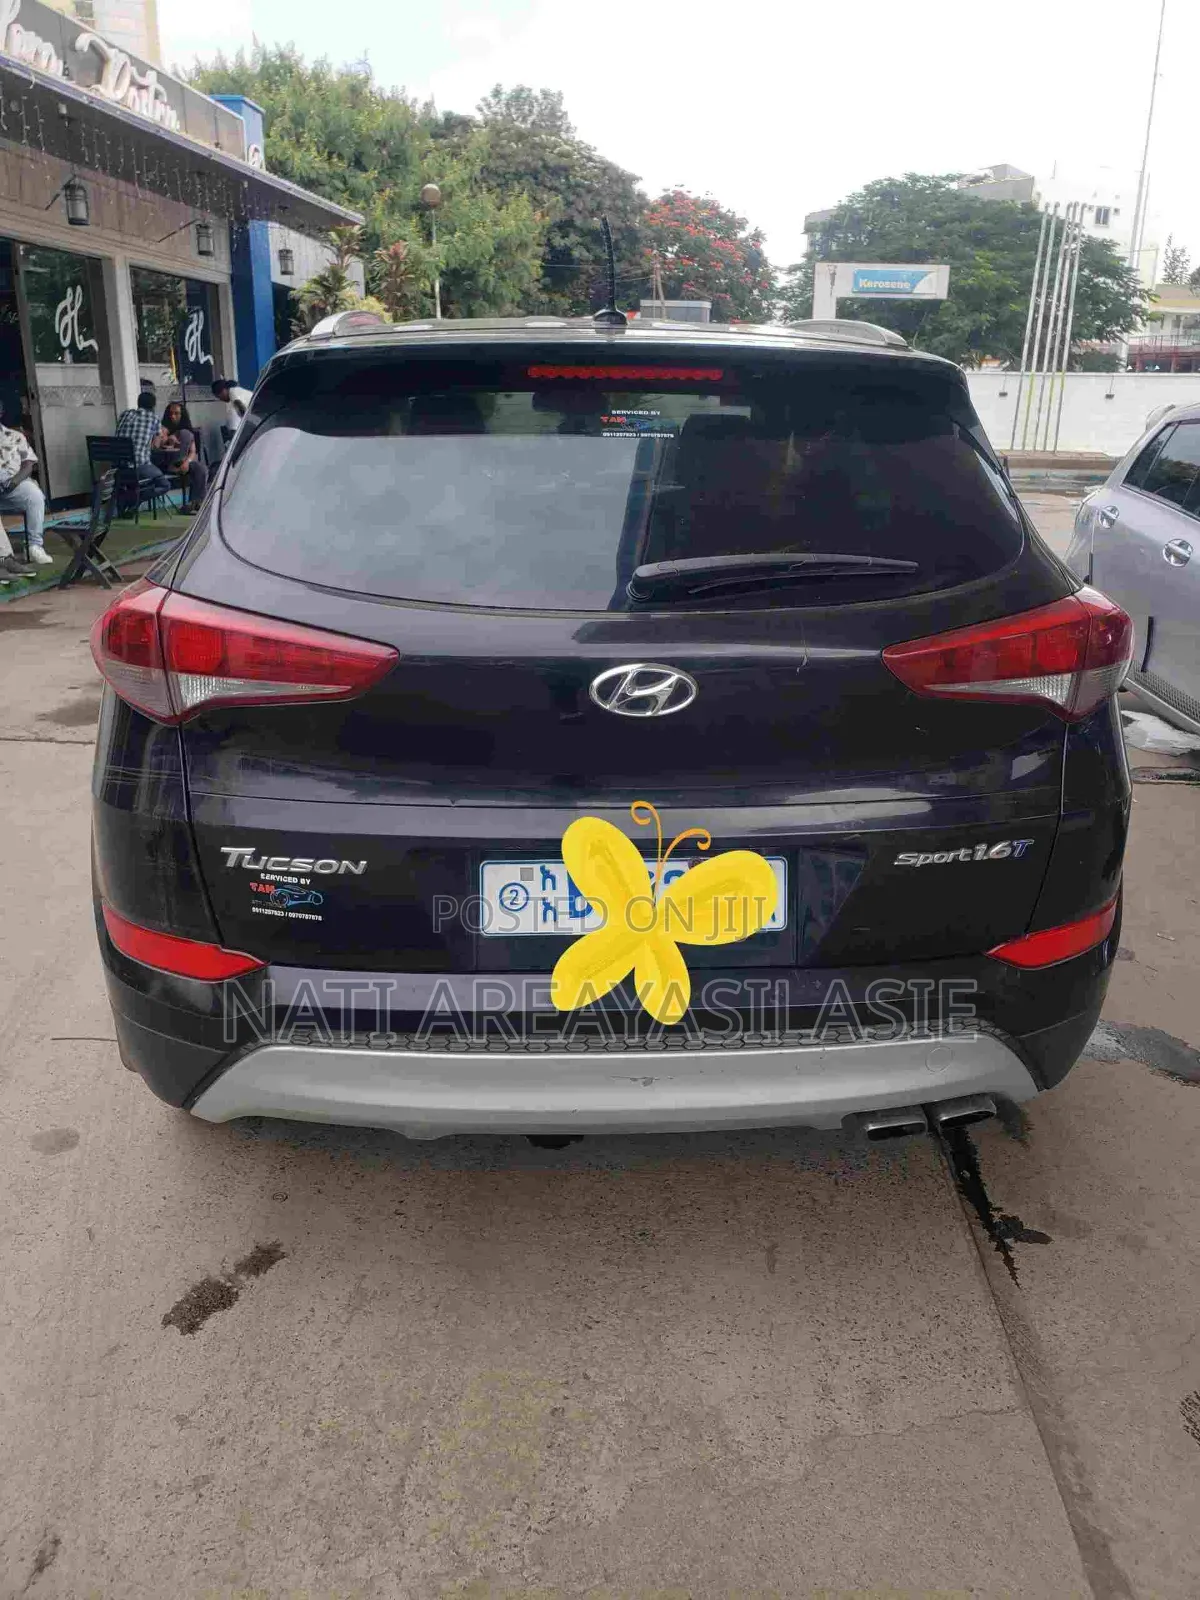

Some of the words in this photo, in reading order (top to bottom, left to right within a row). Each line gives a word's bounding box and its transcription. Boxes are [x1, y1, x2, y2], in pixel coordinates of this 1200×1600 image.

[859, 278, 911, 289] Kerosene
[260, 872, 298, 884] SERVICED
[299, 877, 311, 885] BY
